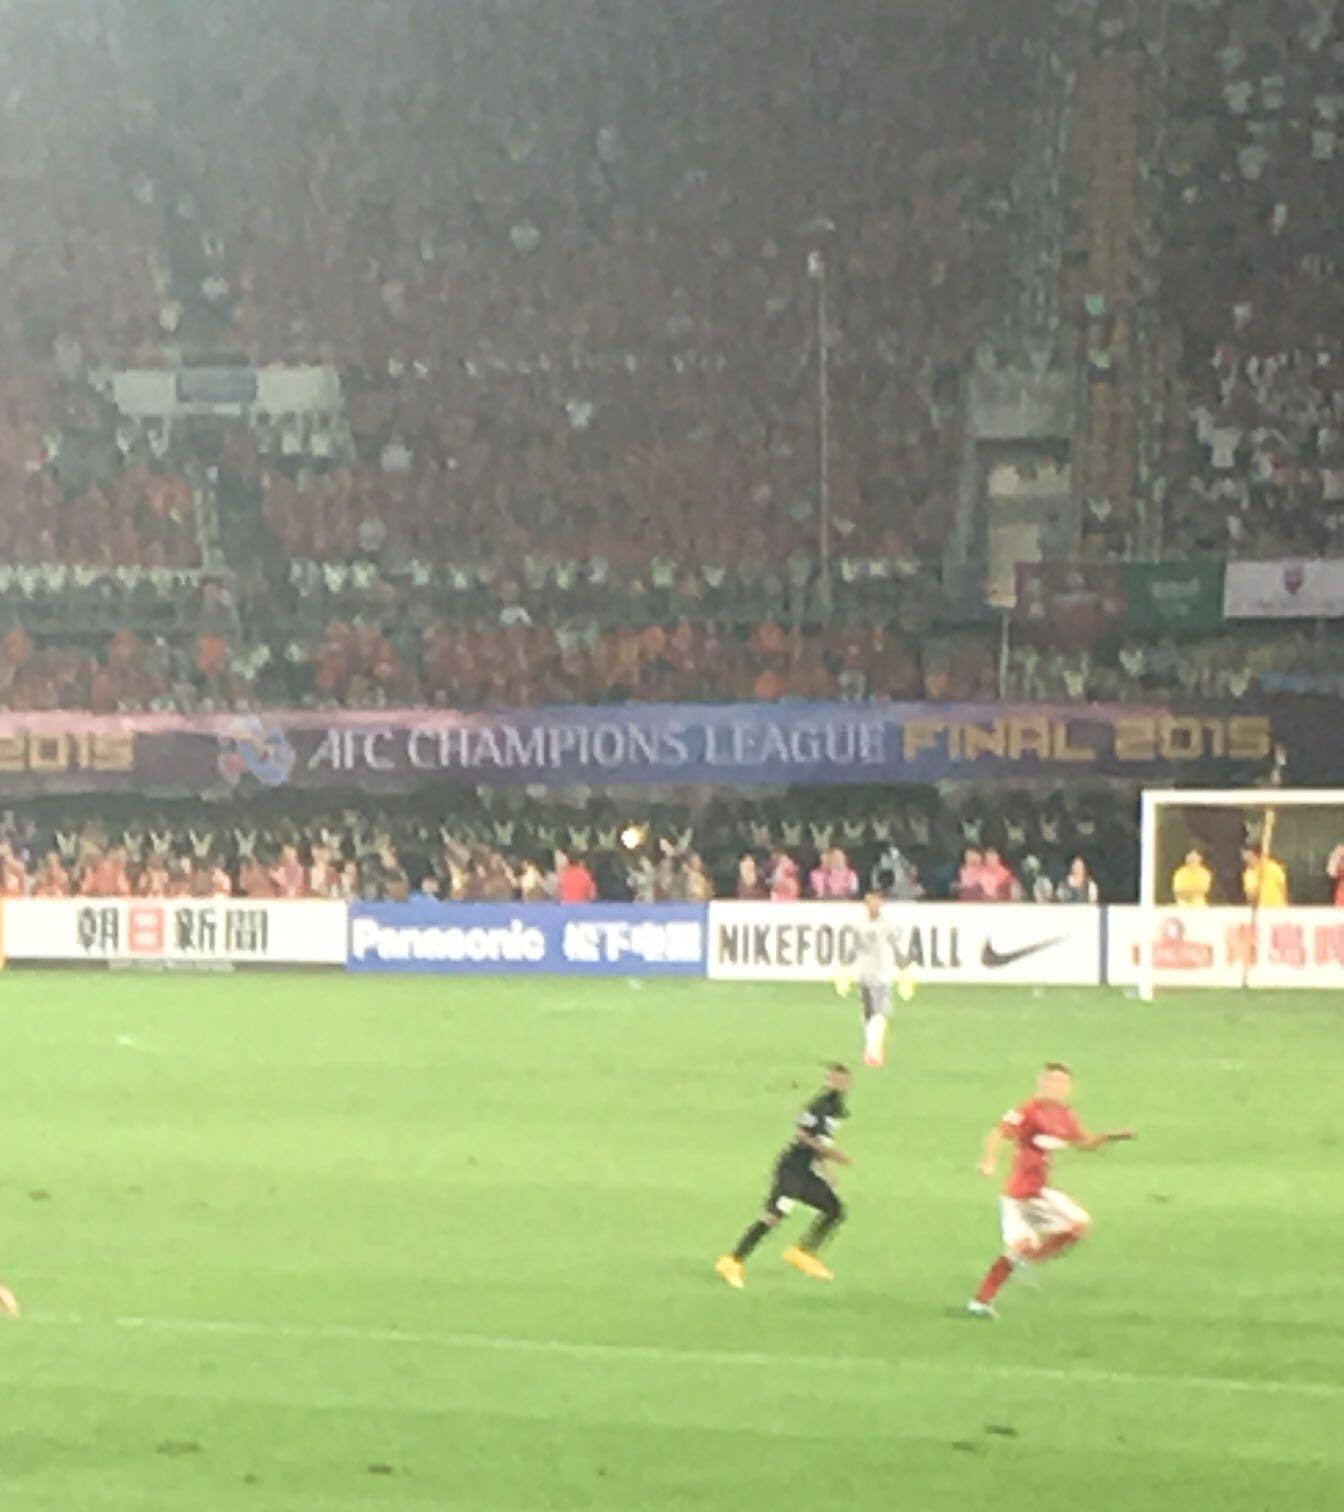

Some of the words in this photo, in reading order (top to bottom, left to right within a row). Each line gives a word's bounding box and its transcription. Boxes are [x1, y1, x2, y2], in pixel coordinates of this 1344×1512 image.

[308, 728, 395, 770] AFC
[407, 722, 690, 769] CHAMPIONS
[704, 720, 887, 764] LEAGUE
[902, 715, 1096, 761] FINAL
[1114, 714, 1271, 761] 2015
[352, 917, 546, 962] Panasonic
[717, 923, 961, 968] NIKEFOOALL
